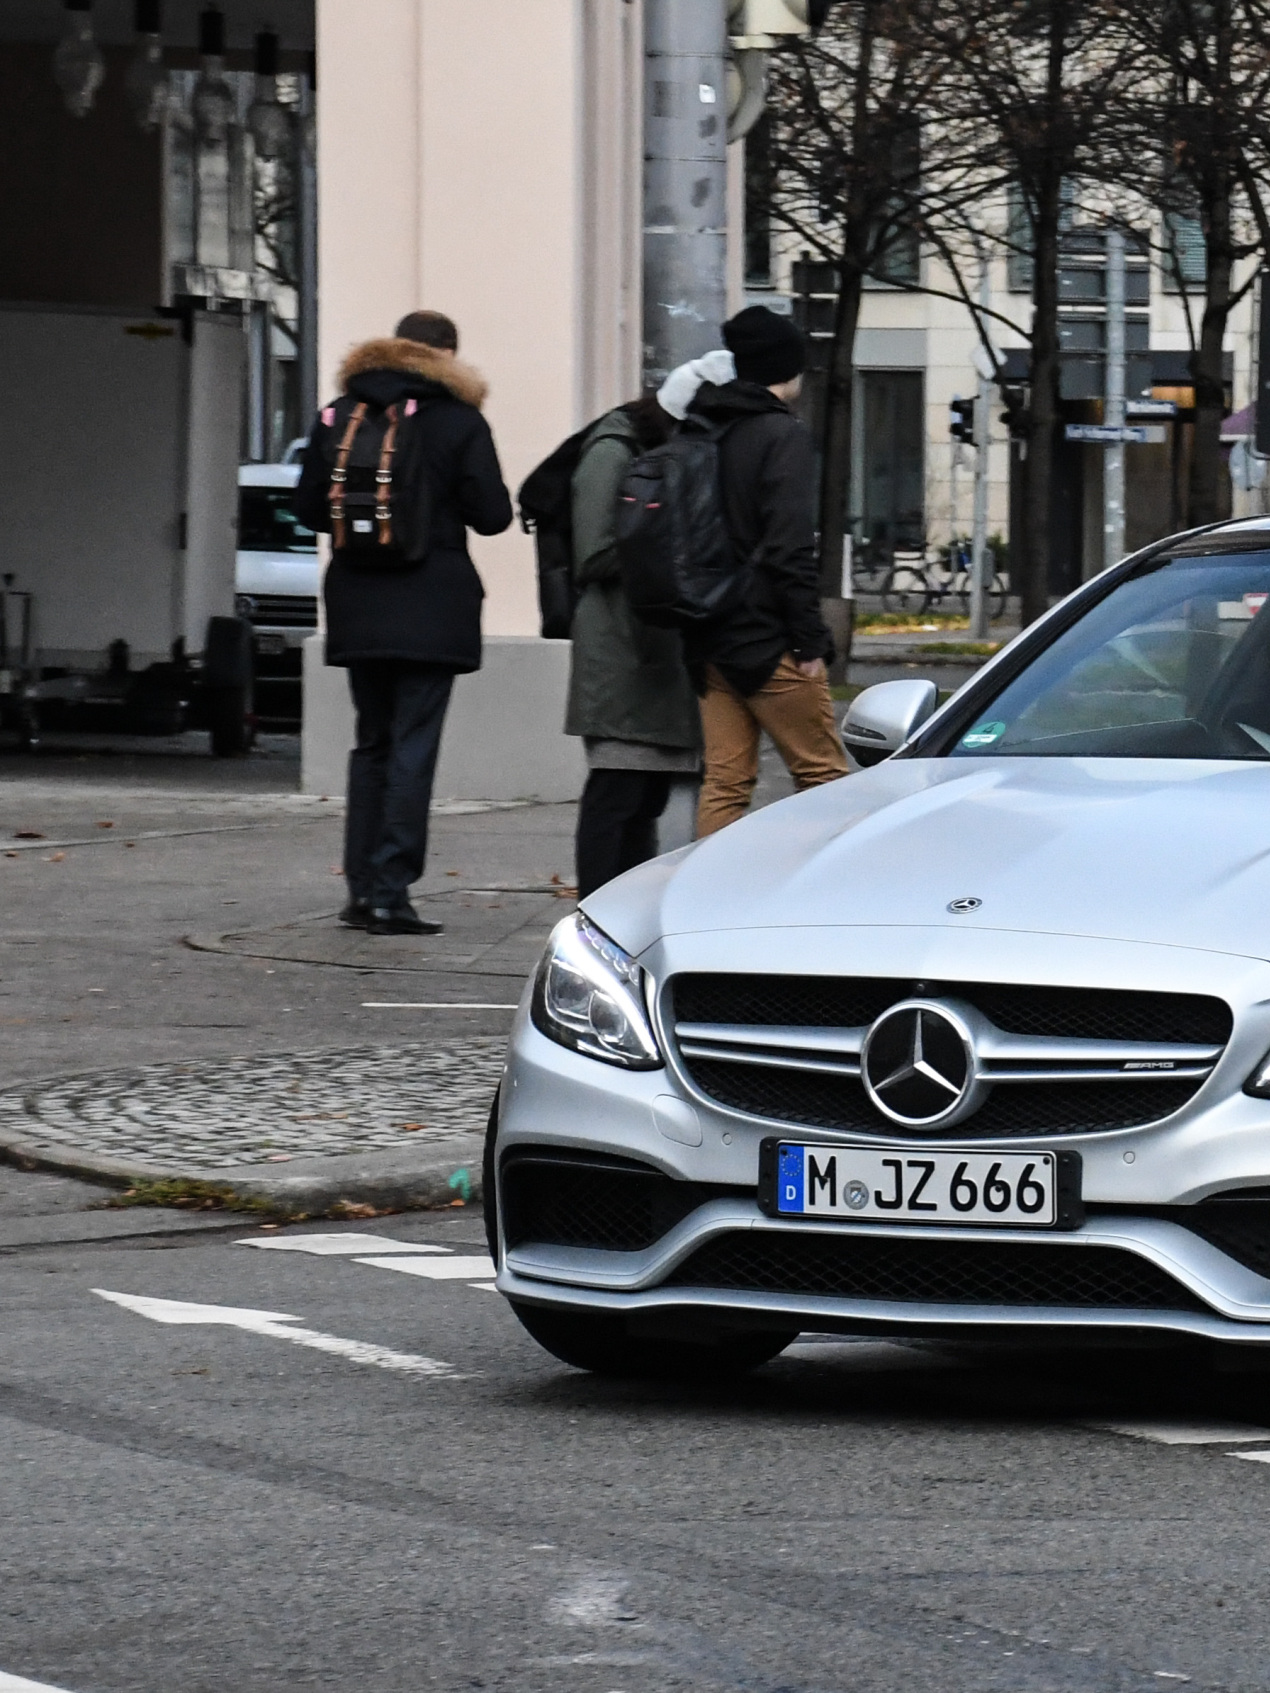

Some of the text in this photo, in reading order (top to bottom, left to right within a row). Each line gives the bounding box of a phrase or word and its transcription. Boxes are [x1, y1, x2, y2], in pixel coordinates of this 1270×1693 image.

[1139, 1061, 1175, 1069] AMG
[808, 1154, 1045, 1214] M JZ 666
[785, 1185, 797, 1201] D
